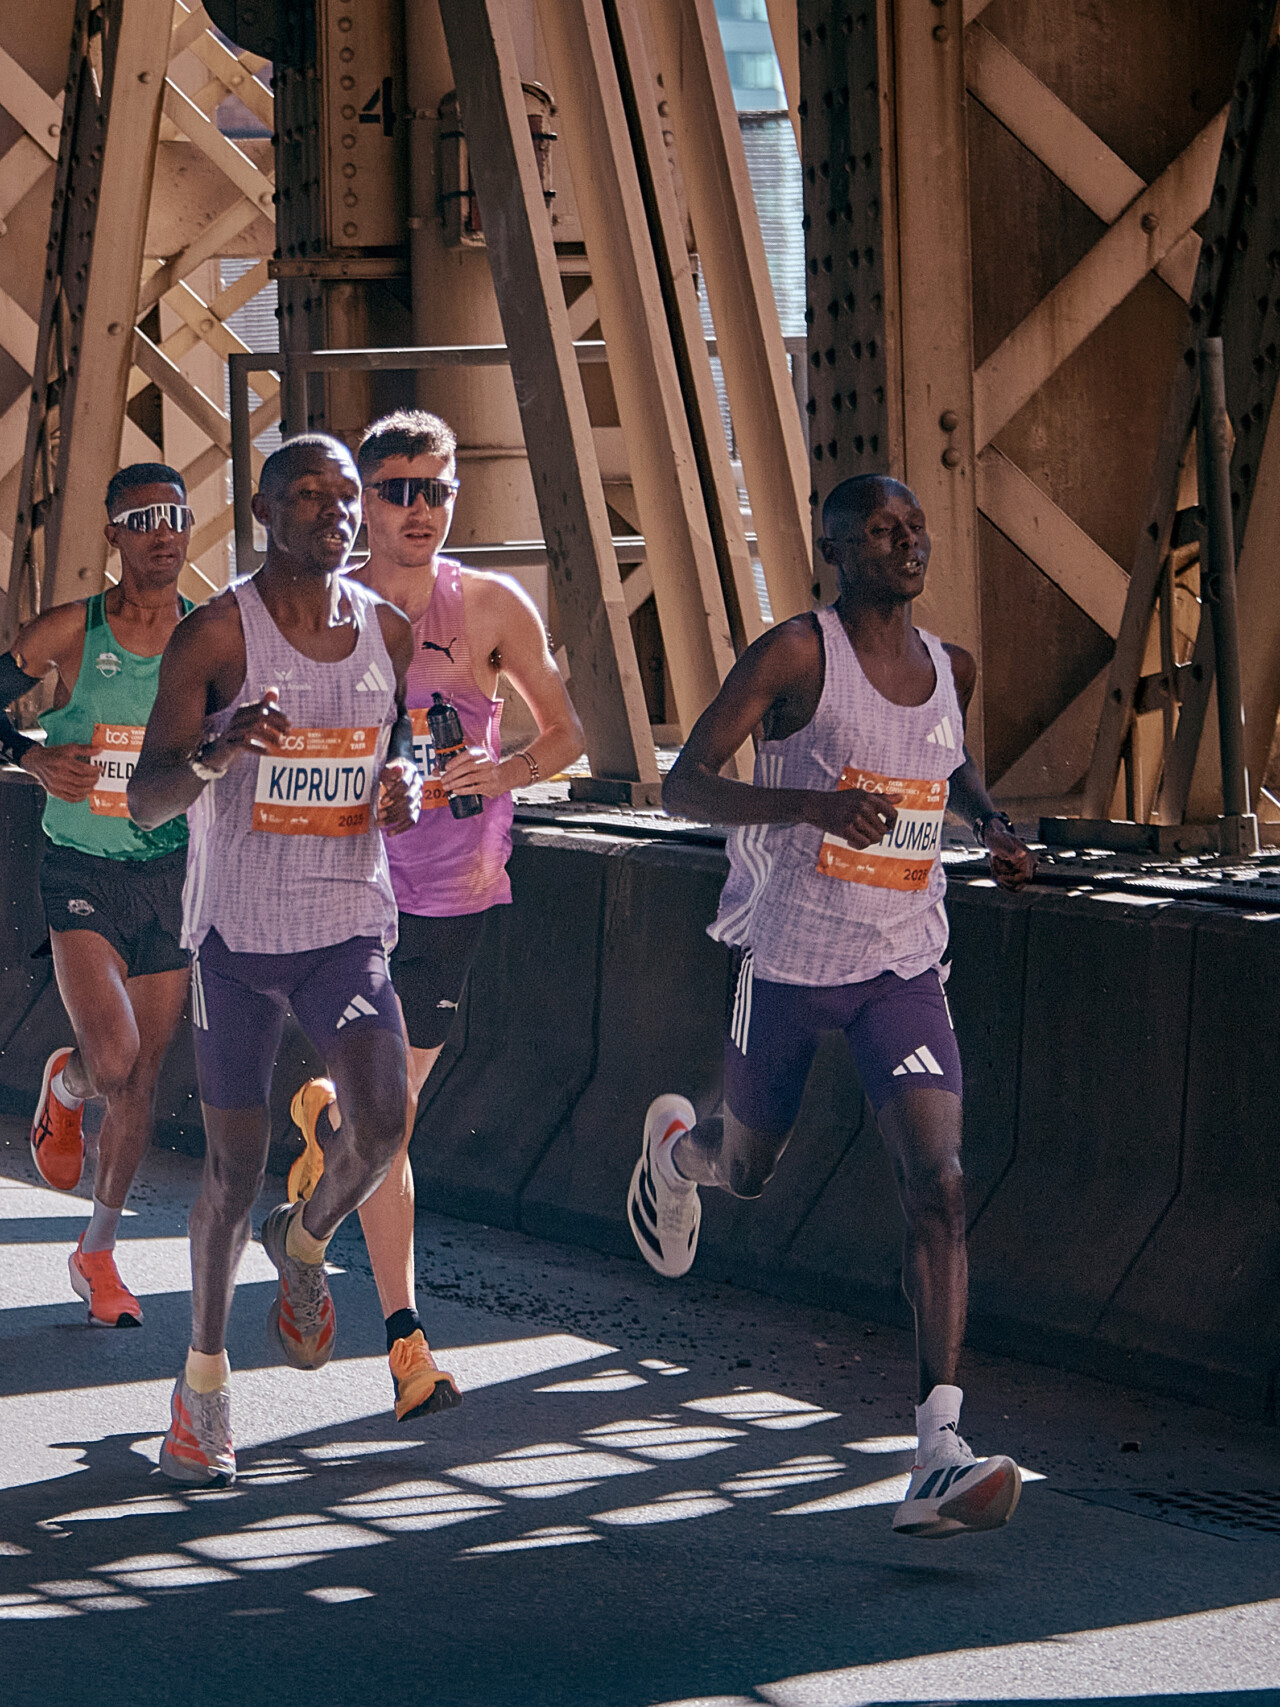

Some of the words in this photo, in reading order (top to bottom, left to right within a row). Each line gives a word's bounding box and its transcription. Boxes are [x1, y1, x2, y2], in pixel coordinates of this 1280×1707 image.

[359, 76, 397, 136] 4
[106, 728, 129, 745] tcs
[268, 765, 366, 802] KIPRUTO
